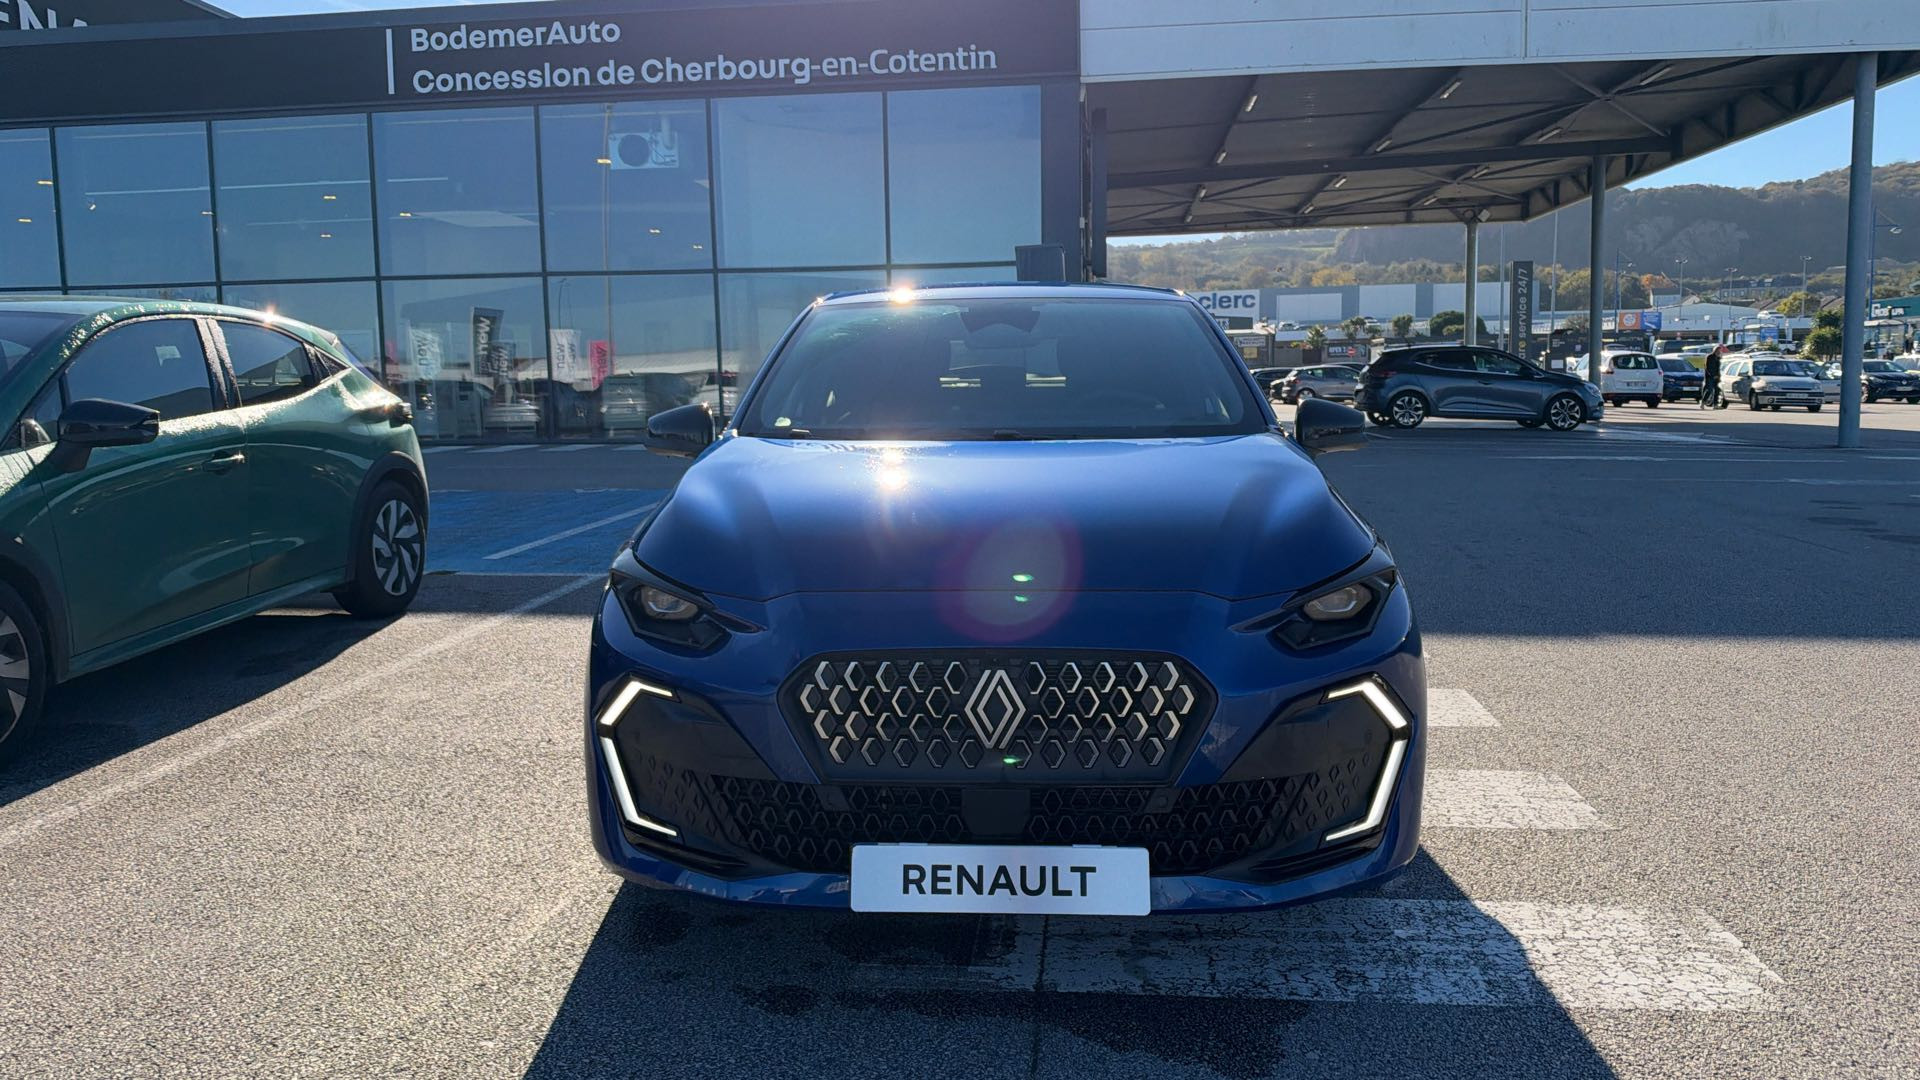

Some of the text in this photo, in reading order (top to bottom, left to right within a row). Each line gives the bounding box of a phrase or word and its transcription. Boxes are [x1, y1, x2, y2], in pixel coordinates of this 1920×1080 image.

[410, 20, 621, 52] BodemerAuto
[597, 59, 635, 86] de
[640, 44, 998, 84] Cherbourg-en-Cotentin
[1518, 268, 1528, 294] 24/7
[1517, 296, 1527, 338] service
[902, 864, 1097, 897] RENAULT
